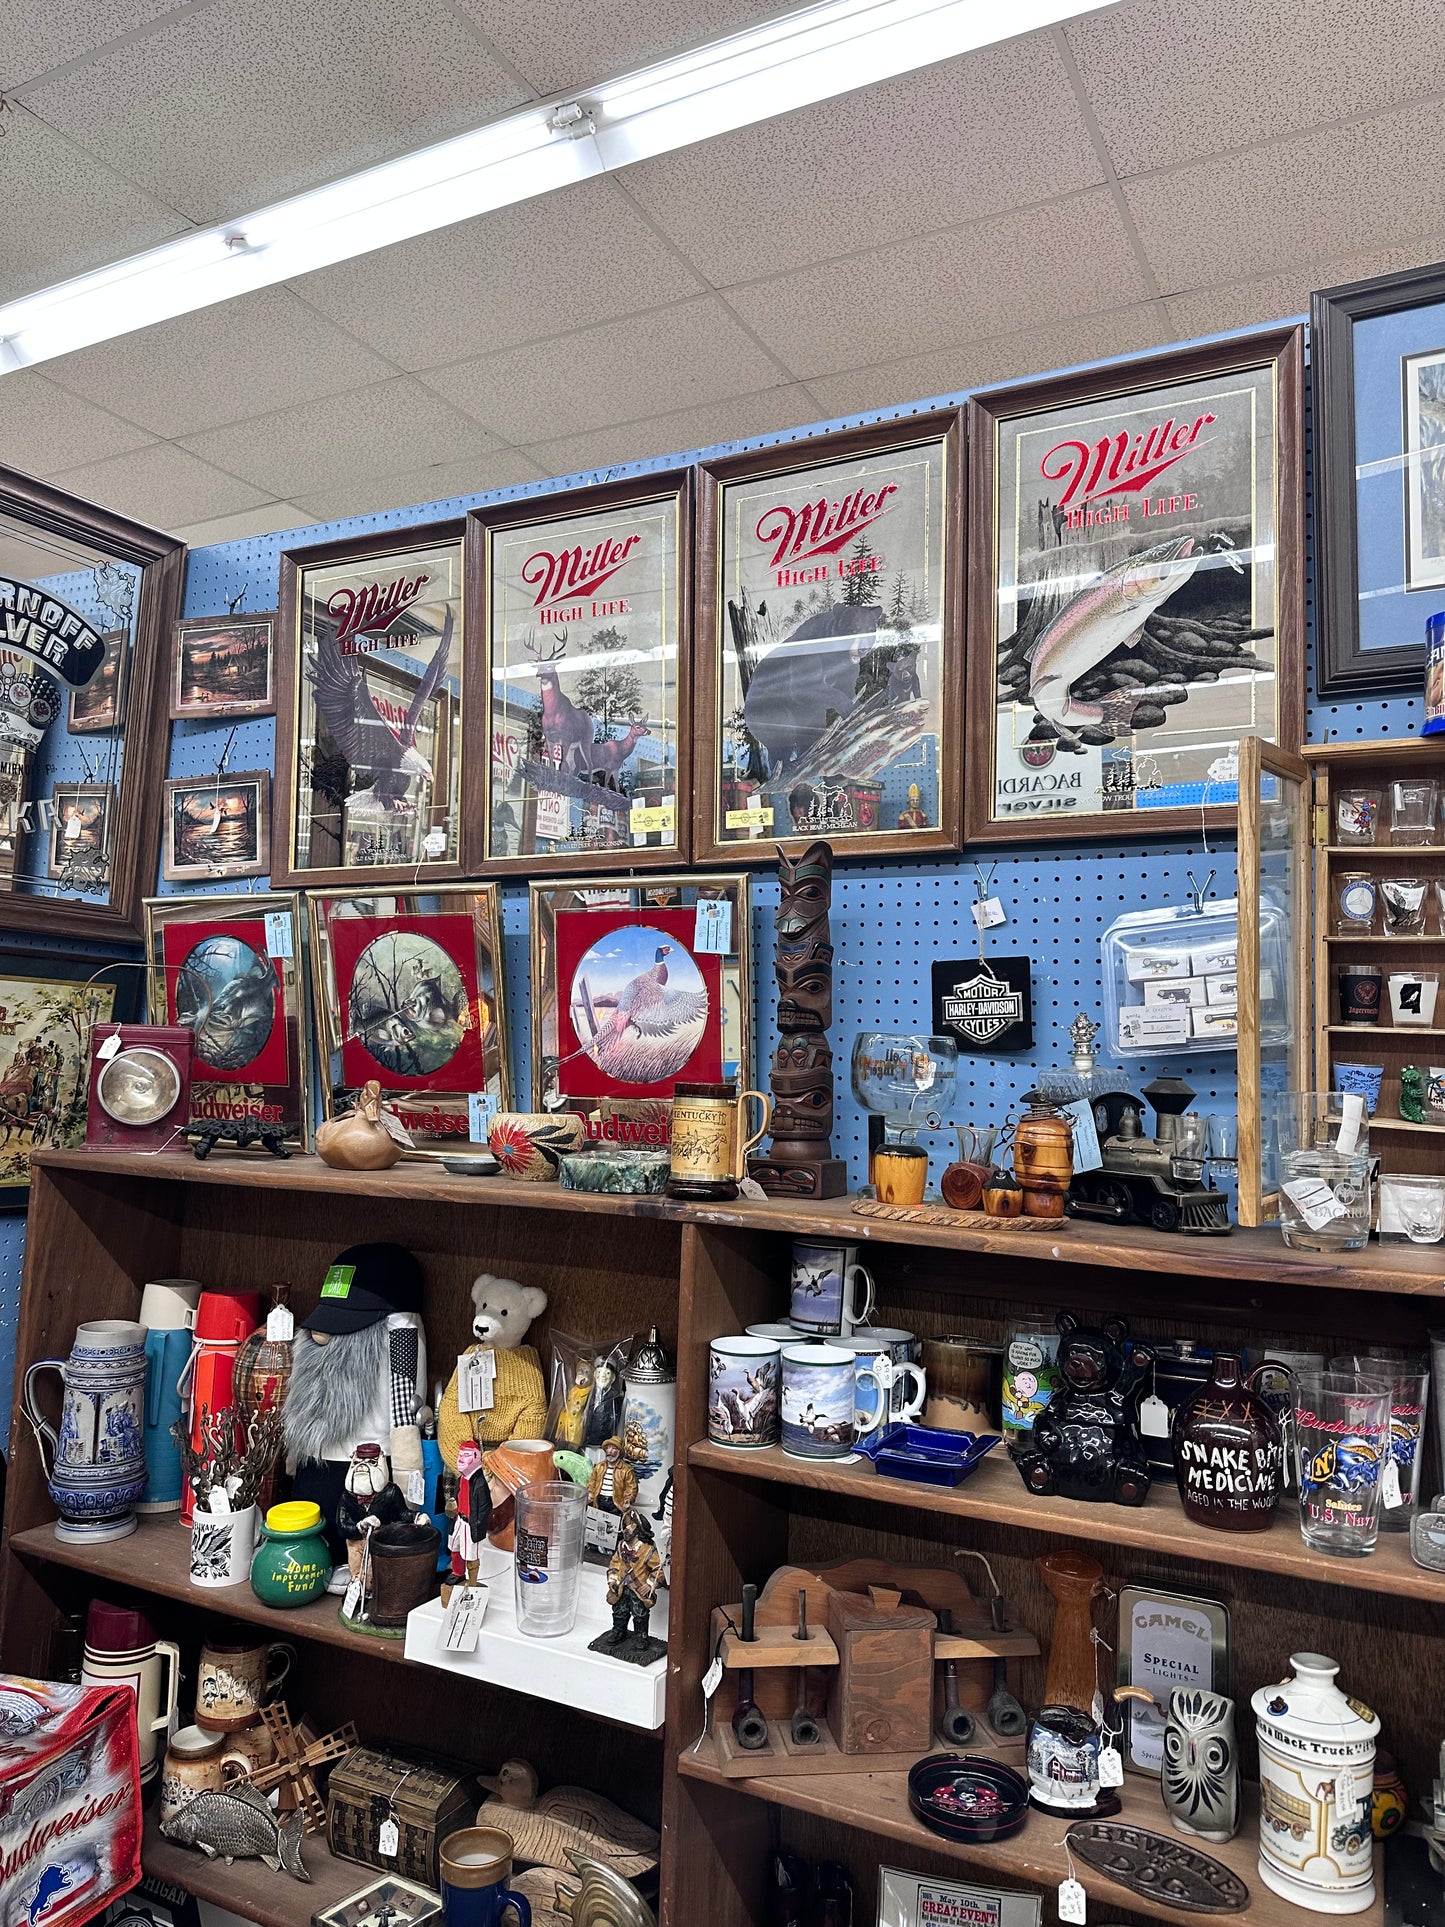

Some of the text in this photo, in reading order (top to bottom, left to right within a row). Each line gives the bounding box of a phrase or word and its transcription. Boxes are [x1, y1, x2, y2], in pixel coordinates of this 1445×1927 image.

[1039, 411, 1219, 509] Miller
[755, 482, 899, 569] Miller
[1065, 493, 1199, 530] HIGH LIFE
[521, 533, 643, 608] Miller
[776, 555, 885, 588] HIGH LIFE
[326, 573, 432, 642] Miller
[540, 599, 629, 625] HIGH LIFE
[341, 633, 420, 656] HIGH LIFE
[827, 821, 858, 830] MICHIGAN
[963, 983, 999, 999] MOTOR
[948, 1000, 1015, 1017] HARLEY-DAVIDSON
[964, 1018, 1000, 1036] CYCLES
[190, 1095, 283, 1123] udweiser
[391, 1104, 470, 1134] weise
[566, 1111, 673, 1145] udwei
[1181, 1440, 1250, 1471] SNAKE
[1187, 1489, 1210, 1507] AGED
[1213, 1497, 1224, 1508] IN
[1227, 1498, 1250, 1511] THE
[1325, 1498, 1363, 1512] Salutes
[1308, 1502, 1377, 1530] U.S. Navy
[287, 1562, 317, 1574] Home
[287, 1579, 316, 1593] Fund
[1134, 1613, 1210, 1643] CAMEL
[1143, 1652, 1200, 1676] SPECIAL
[1274, 1728, 1308, 1752] Mack
[1089, 1824, 1240, 1906] BEWARE
[1102, 1854, 1191, 1899] DOG
[138, 1876, 188, 1906] HIGAN
[940, 1895, 957, 1906] May
[960, 1899, 980, 1909] 10th.
[922, 1901, 998, 1925] GREAT EVENT
